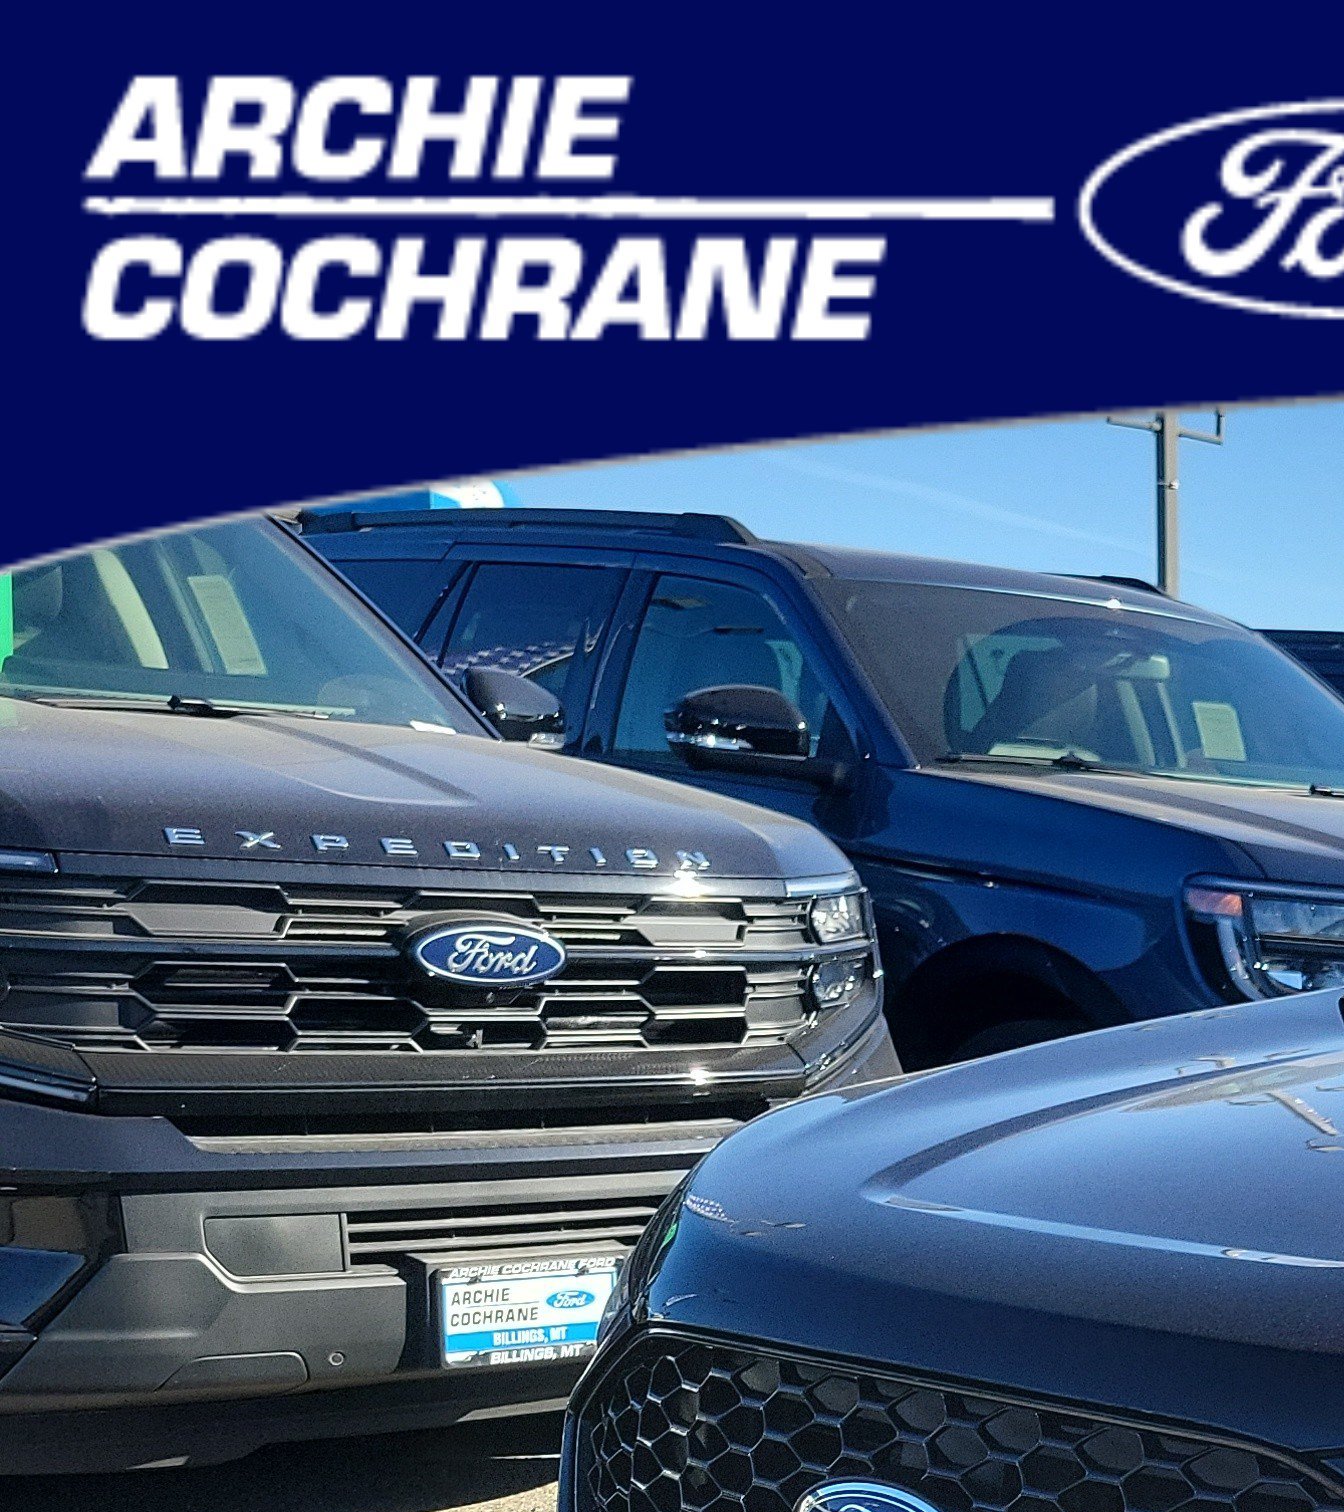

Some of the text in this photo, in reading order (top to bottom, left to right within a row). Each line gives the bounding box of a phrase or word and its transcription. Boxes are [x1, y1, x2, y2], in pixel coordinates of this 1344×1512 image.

[163, 827, 711, 871] EXPEDITION
[448, 933, 538, 977] Ford
[450, 1257, 616, 1279] ARCHIE COCHRANE FORD
[451, 1288, 511, 1306] ARCHIE
[552, 1290, 587, 1308] Ford
[450, 1307, 539, 1327] COCHRANE
[493, 1326, 568, 1347] BILLINGS, MT
[490, 1344, 584, 1365] BILLINGS, MT
